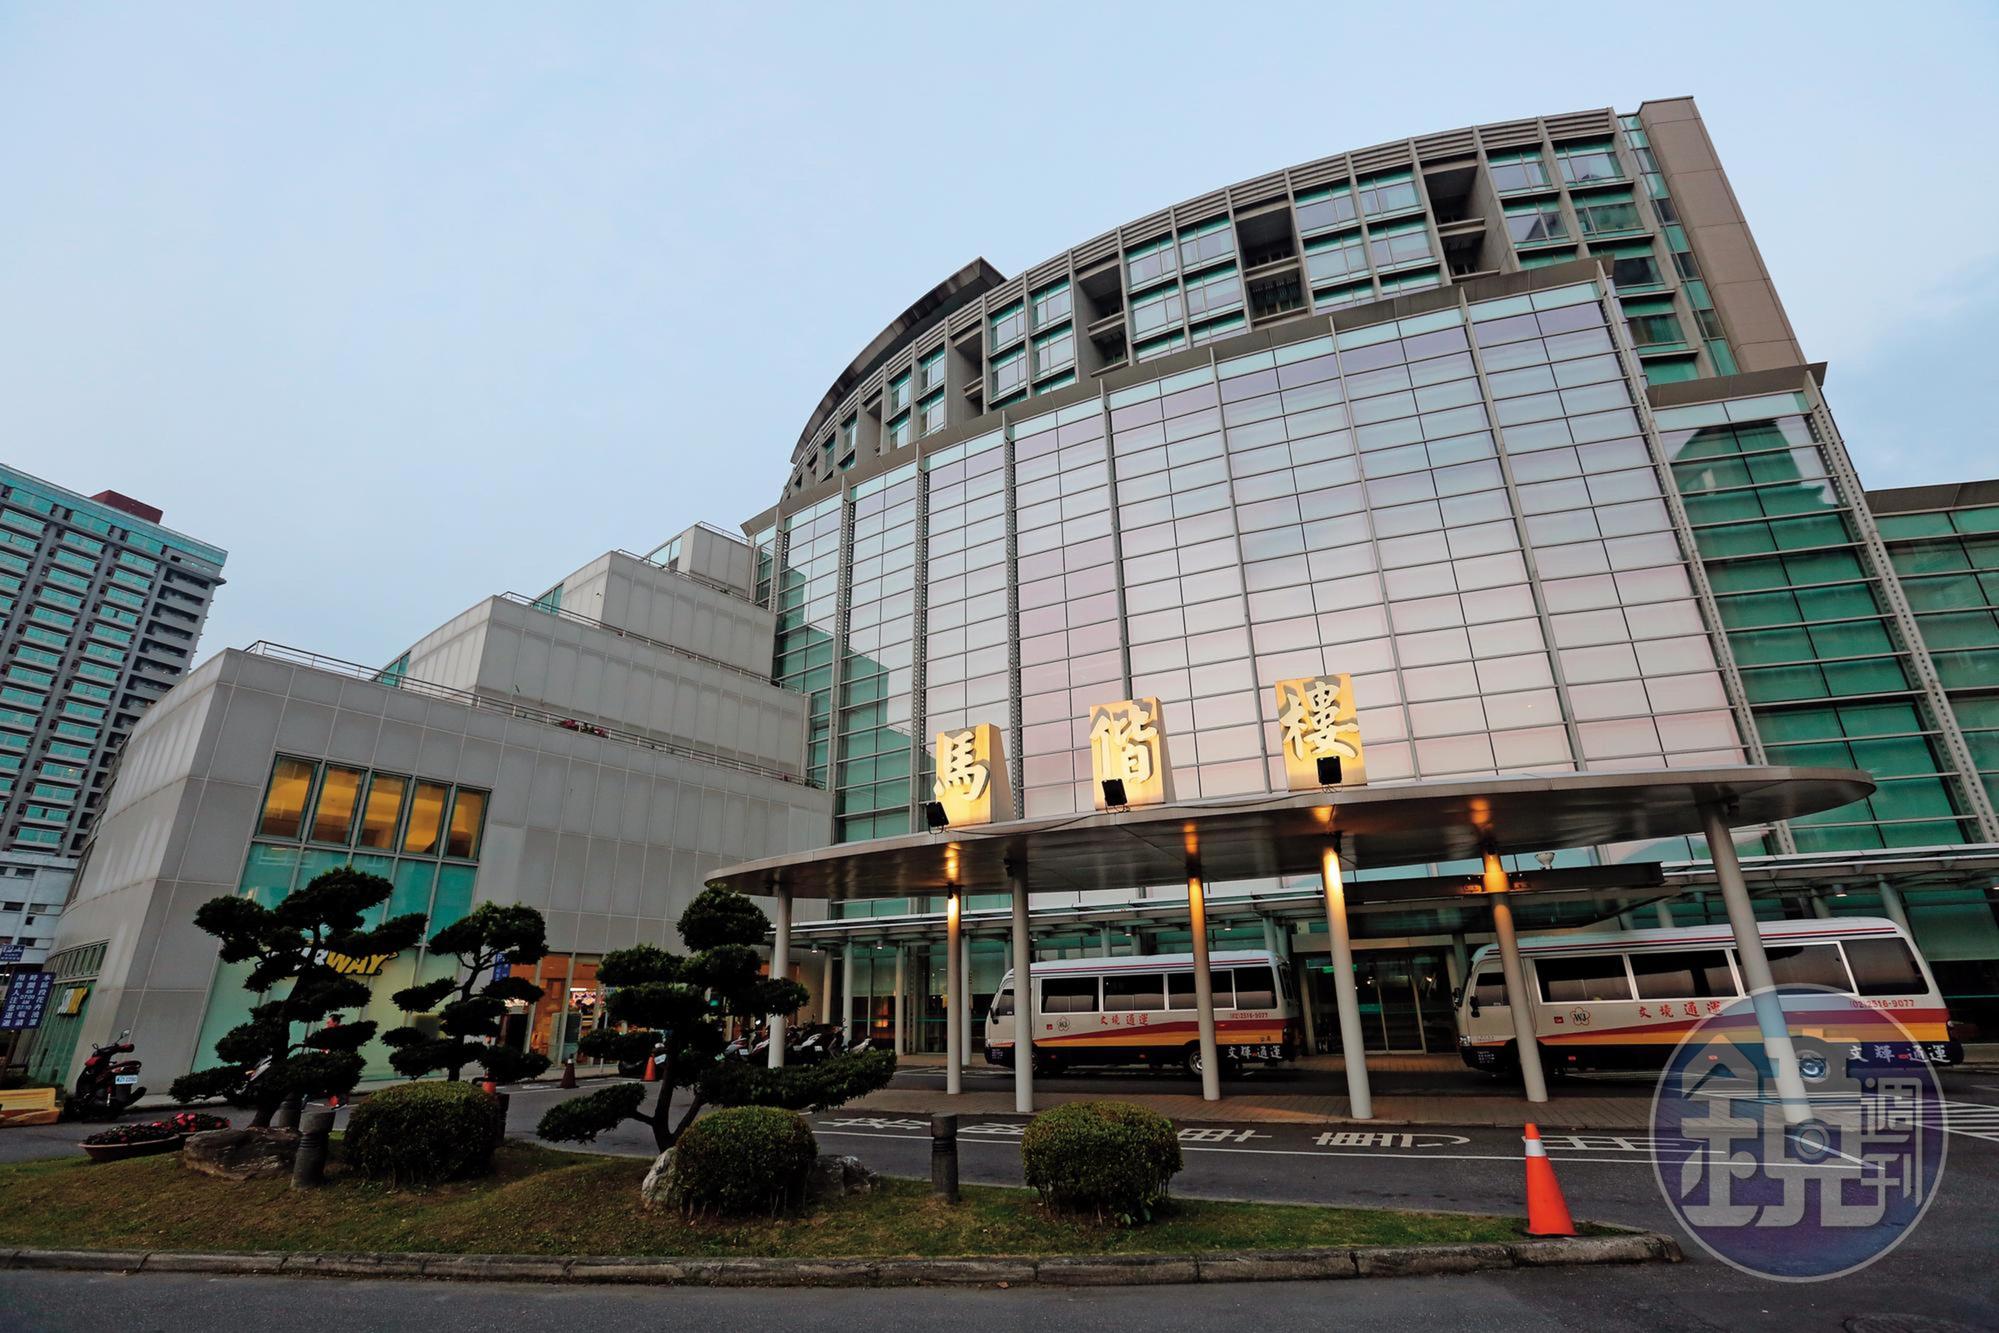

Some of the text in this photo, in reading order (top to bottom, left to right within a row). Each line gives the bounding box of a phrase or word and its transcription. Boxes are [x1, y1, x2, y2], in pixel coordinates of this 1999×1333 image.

[932, 681, 1359, 801] 馬偕樓
[1638, 1000, 1723, 1019] 文境通運
[1849, 1044, 1951, 1063] 文輝通運
